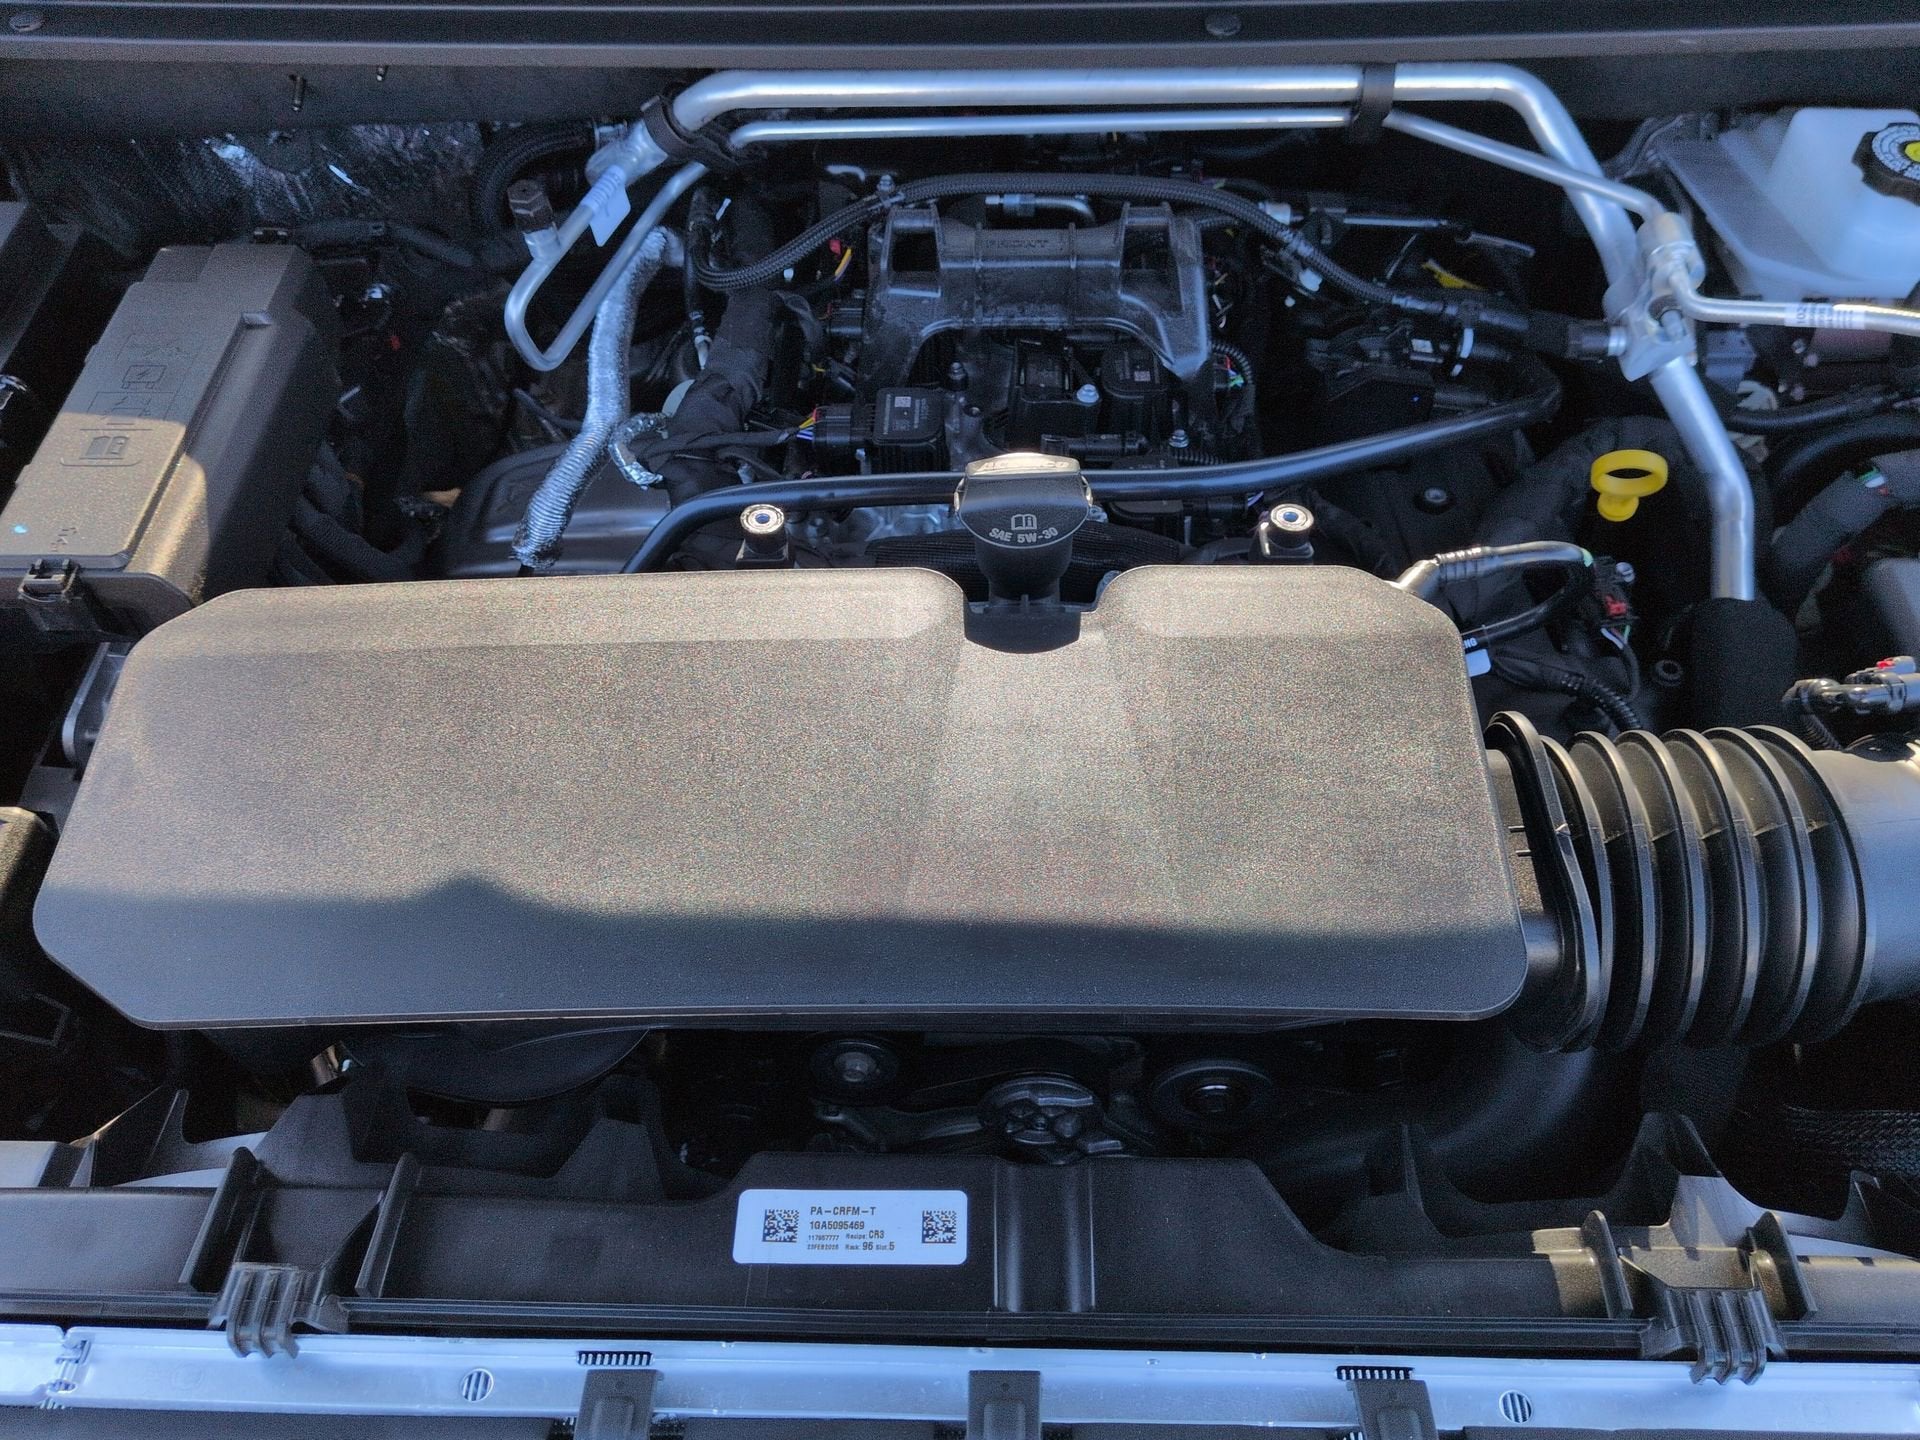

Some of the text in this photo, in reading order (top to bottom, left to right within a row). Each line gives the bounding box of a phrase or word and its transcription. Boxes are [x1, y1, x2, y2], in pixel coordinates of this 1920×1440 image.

[989, 527, 1059, 543] SAE 5W-30
[868, 1230, 885, 1239] CR3
[862, 1241, 874, 1250] 96
[888, 1241, 896, 1250] 5
